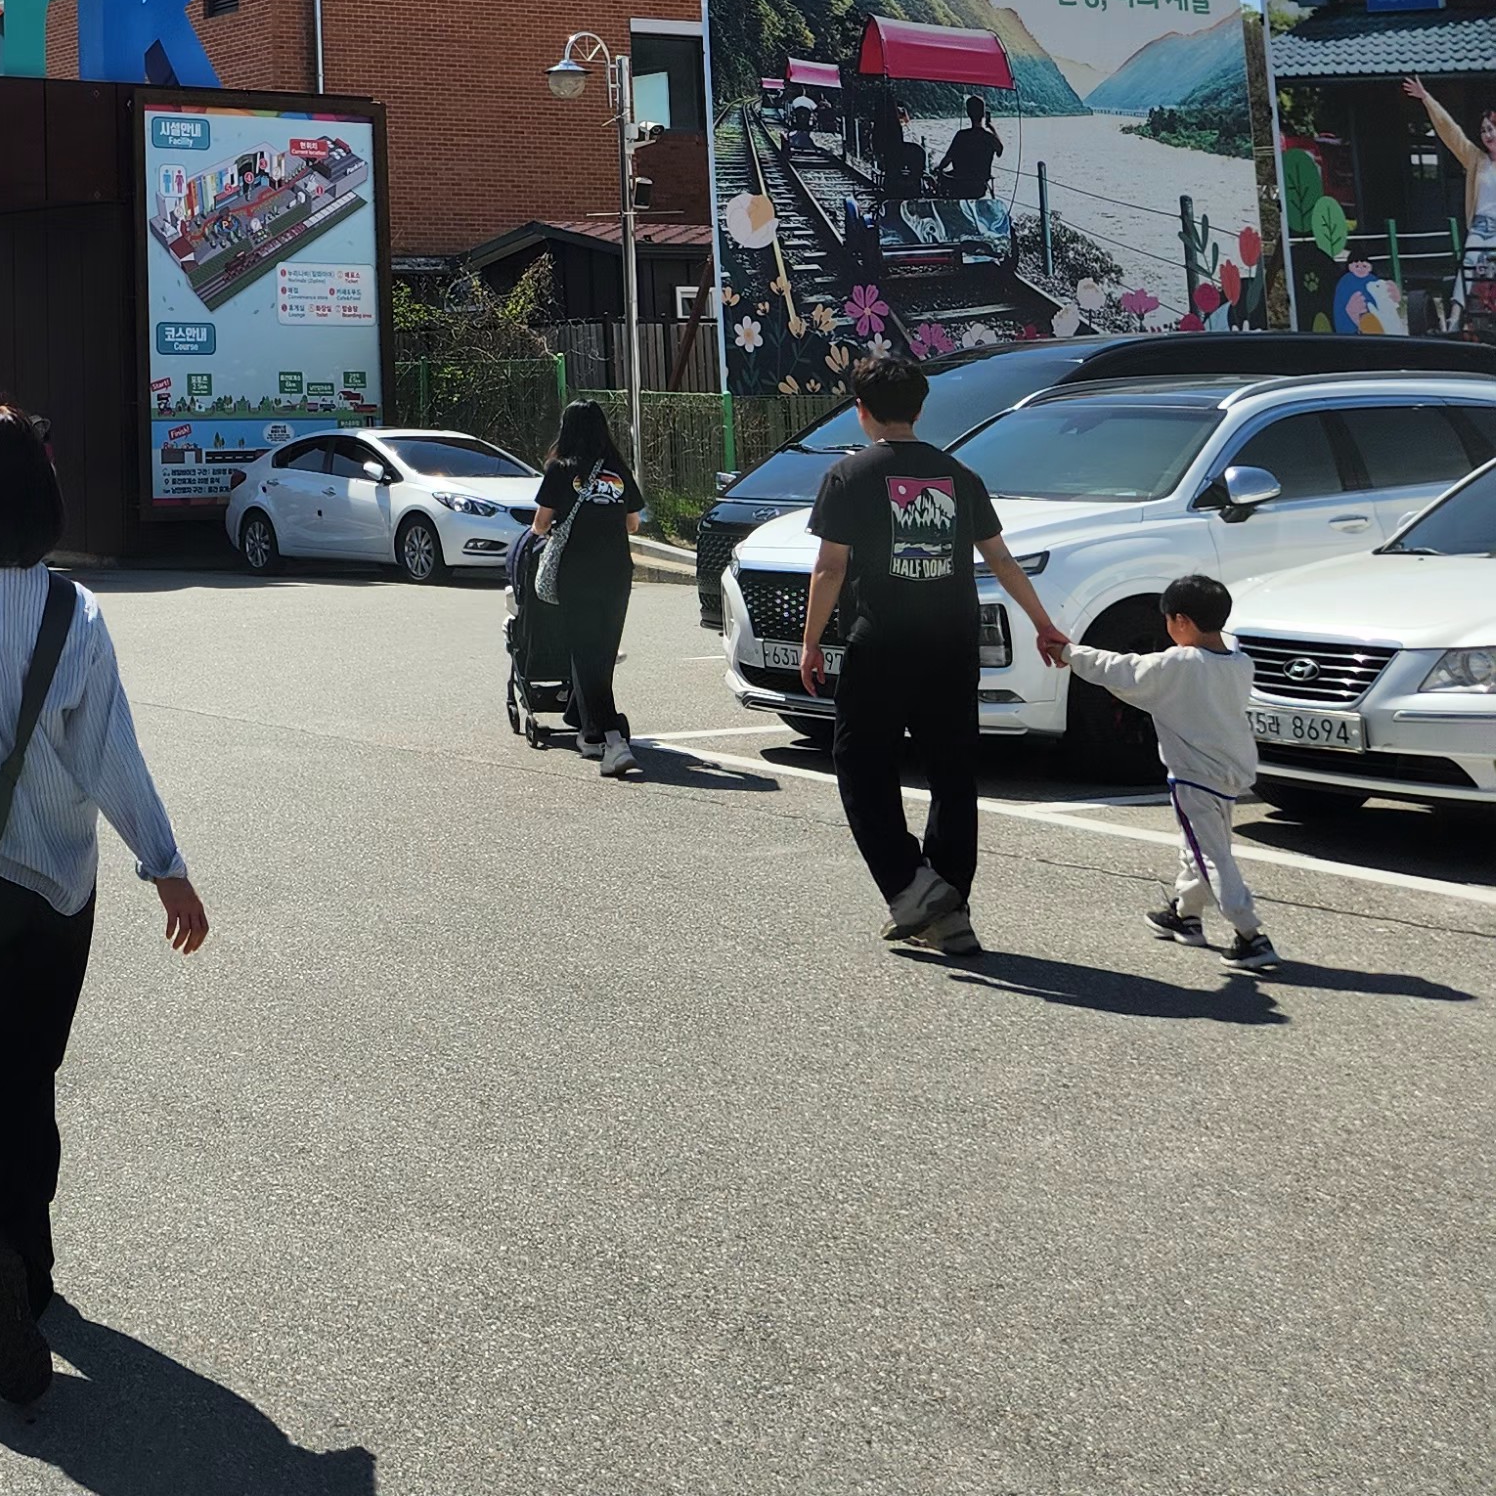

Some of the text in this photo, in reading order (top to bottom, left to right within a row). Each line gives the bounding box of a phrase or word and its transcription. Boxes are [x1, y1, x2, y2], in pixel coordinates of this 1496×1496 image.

[159, 121, 202, 138] 시설안내
[168, 137, 194, 148] Facility
[164, 326, 207, 342] 코스안내
[173, 342, 199, 351] Course
[170, 425, 191, 439] Finish!
[892, 557, 952, 579] HALF DOME
[1292, 715, 1351, 744] 8694
